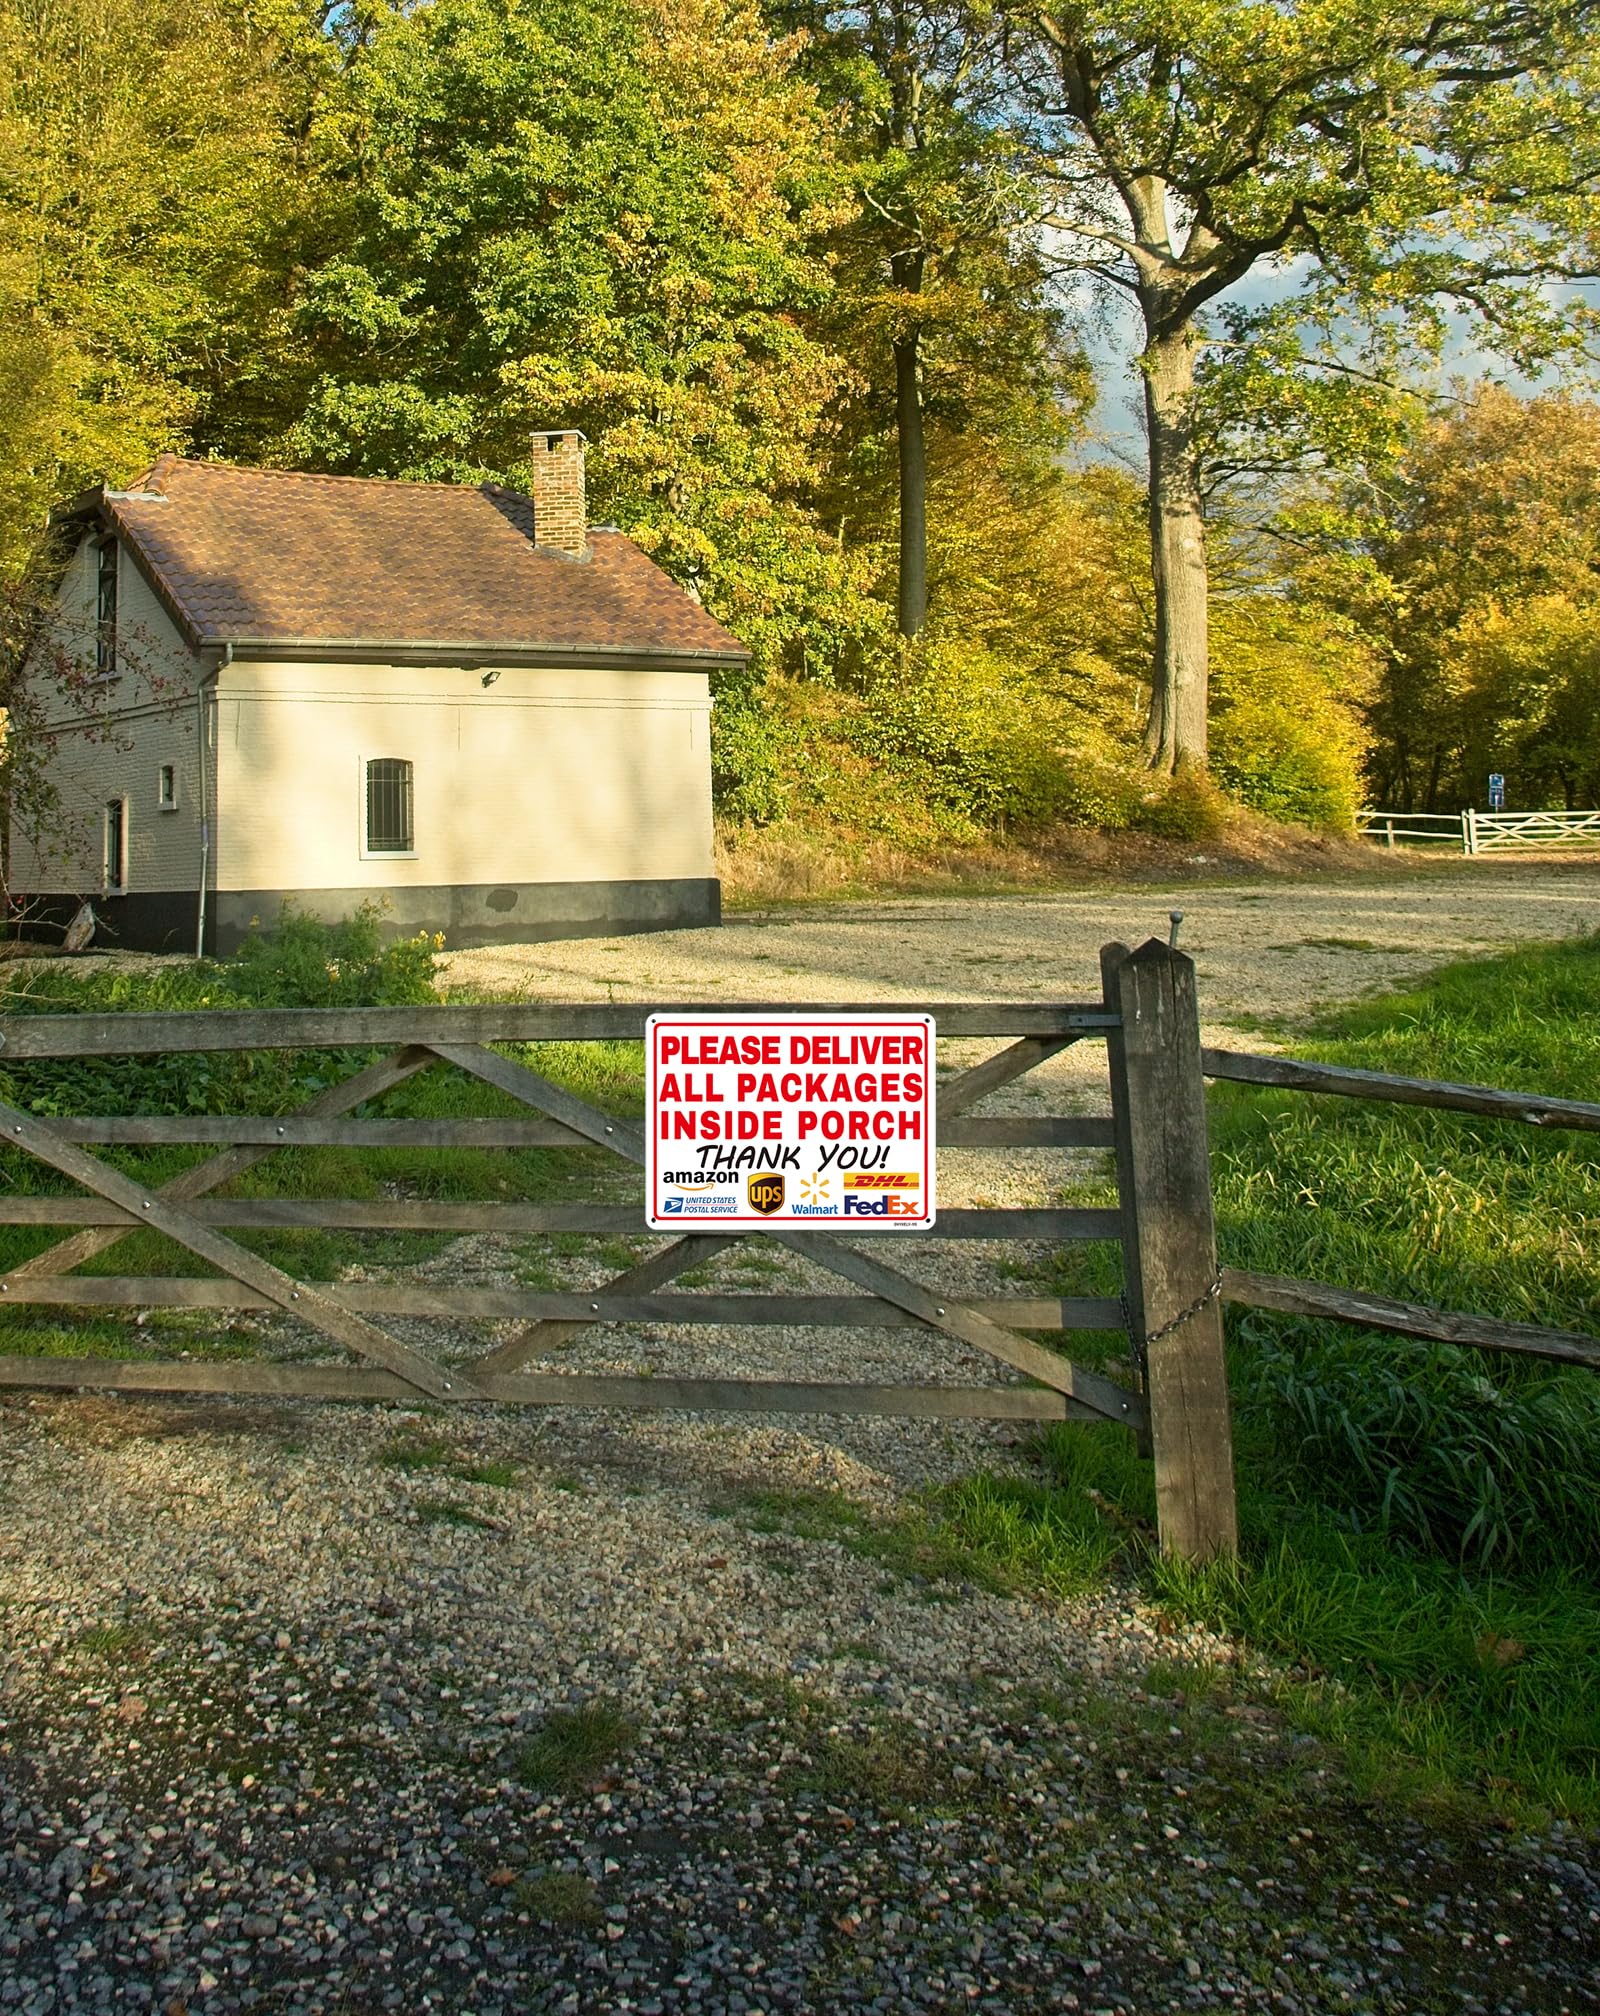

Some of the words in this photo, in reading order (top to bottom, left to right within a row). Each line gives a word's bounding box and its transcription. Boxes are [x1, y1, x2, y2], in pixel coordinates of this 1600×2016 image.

[660, 1036, 781, 1065] PLEASE
[790, 1036, 923, 1065] DELIVER
[659, 1073, 724, 1102] ALL
[737, 1073, 923, 1102] PACKAGES
[660, 1111, 782, 1140] INSIDE
[798, 1111, 920, 1140] PORCH
[696, 1143, 801, 1170] THANK
[817, 1143, 891, 1173] YOU!
[663, 1171, 739, 1184] amazon
[854, 1175, 909, 1187] DHL
[751, 1186, 782, 1209] ups
[844, 1195, 919, 1215] FedEx
[792, 1204, 839, 1215] Walmart
